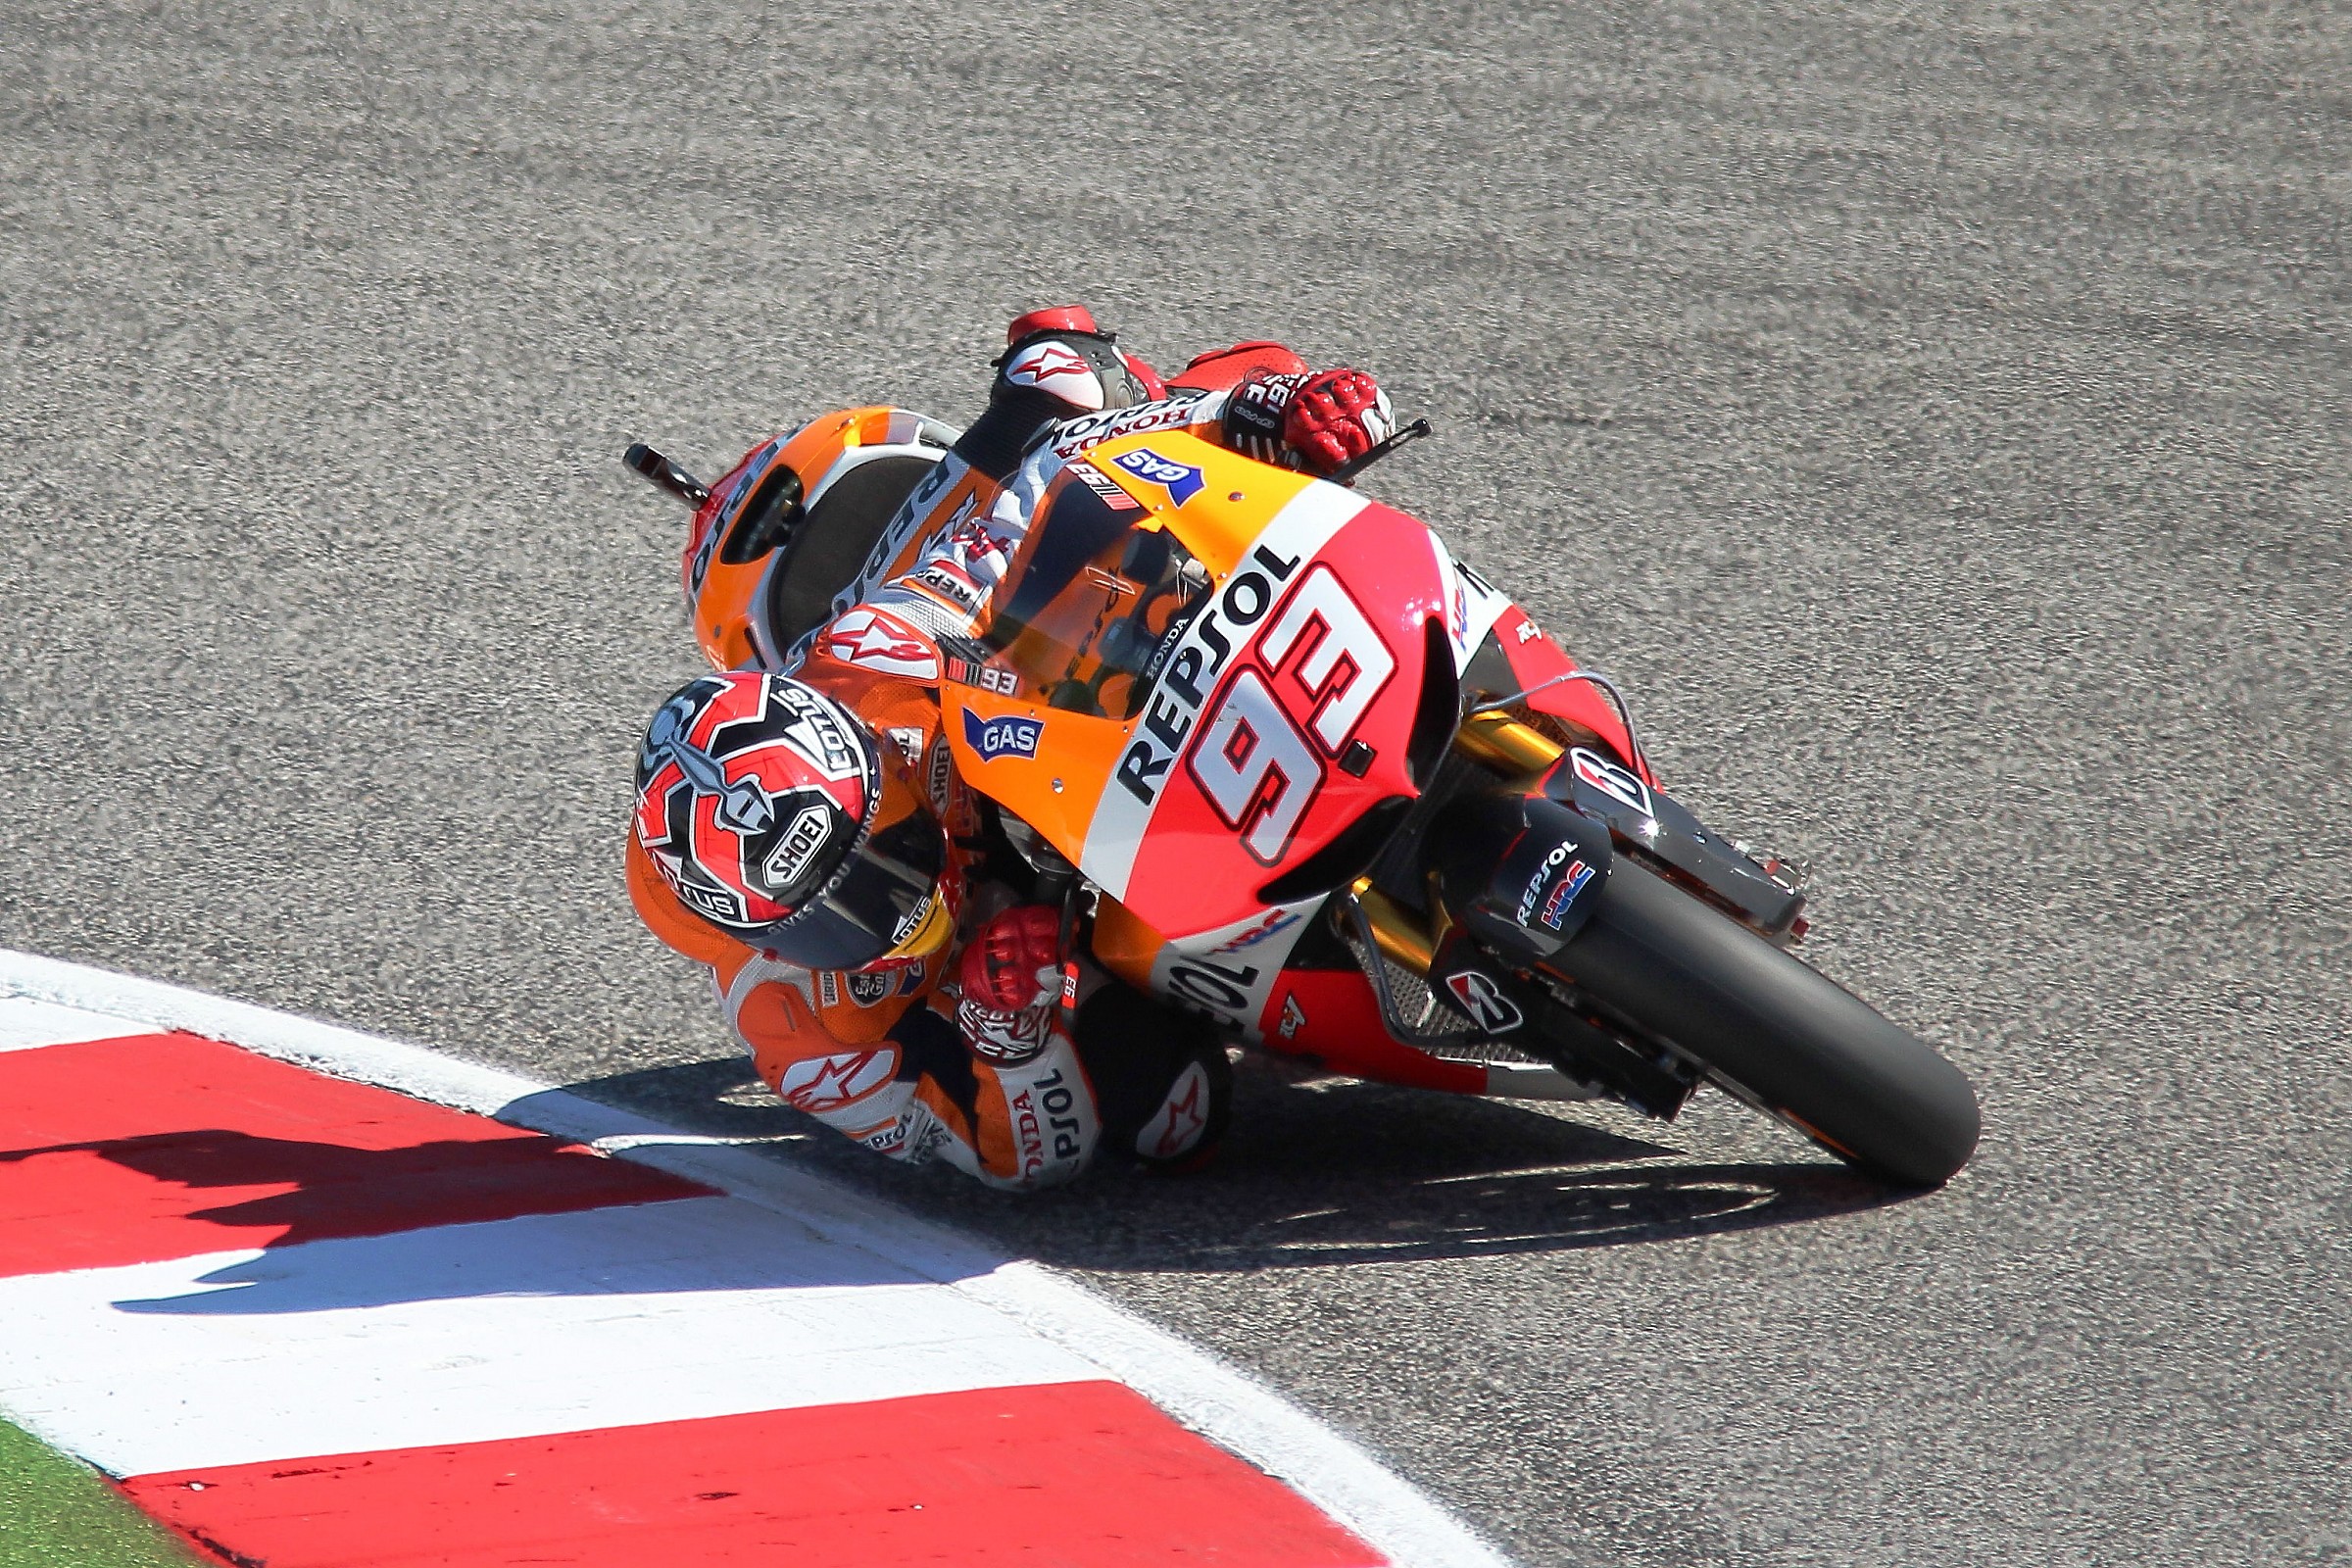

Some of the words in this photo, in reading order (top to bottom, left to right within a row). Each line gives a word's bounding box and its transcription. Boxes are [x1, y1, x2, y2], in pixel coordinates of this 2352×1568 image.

[1054, 407, 1192, 460] HONDA
[1066, 463, 1109, 489] 93
[1122, 451, 1192, 482] GAS
[1116, 544, 1301, 807] REPSOL
[1146, 617, 1190, 680] HONDA
[981, 667, 1019, 697] 93
[778, 688, 853, 769] LOTUS
[983, 724, 1036, 753] GAS
[1186, 562, 1398, 867] 93
[931, 745, 951, 804] SHOEI
[770, 814, 825, 879] SHOEI
[817, 862, 851, 900] YOU
[851, 787, 883, 854] WINGS
[1517, 840, 1579, 928] REPSOL
[1541, 859, 1596, 931] HRC
[892, 896, 932, 946] LOTUS
[1064, 975, 1077, 1000] 93
[1012, 1089, 1044, 1176] ONDA
[1033, 1067, 1081, 1166] PSOL
